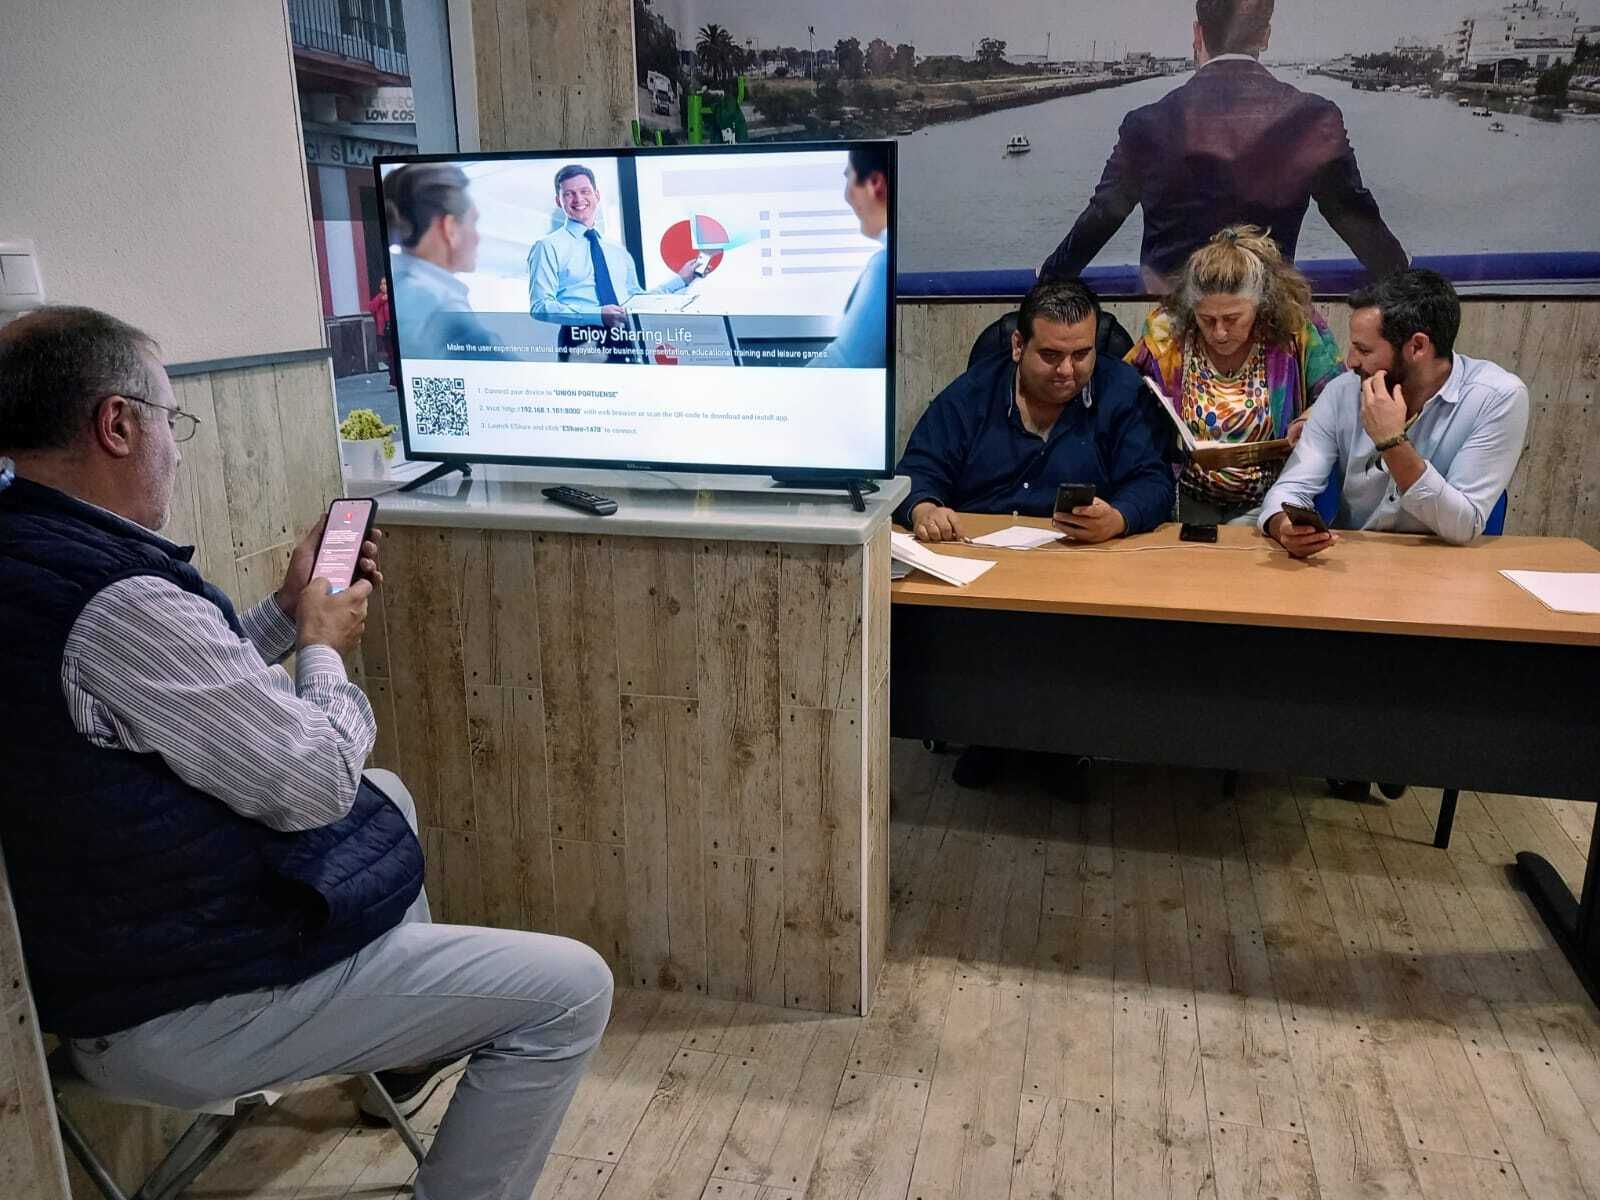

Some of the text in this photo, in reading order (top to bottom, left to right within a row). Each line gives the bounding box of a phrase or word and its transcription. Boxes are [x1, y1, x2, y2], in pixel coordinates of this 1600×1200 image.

[366, 109, 415, 121] LOW COS
[571, 326, 693, 344] Enjoy Sharing Life
[446, 343, 465, 352] Make
[466, 343, 477, 352] the
[478, 345, 492, 353] user
[493, 344, 529, 354] experience
[530, 344, 554, 353] natural
[556, 346, 568, 354] and
[569, 346, 601, 356] enjoyable
[602, 346, 612, 354] for
[613, 347, 644, 356] business
[691, 348, 732, 356] educational
[733, 348, 760, 359] training
[762, 349, 776, 358] and
[777, 349, 801, 358] leisure
[611, 408, 637, 416] browser
[662, 409, 672, 417] the
[533, 423, 544, 431] and
